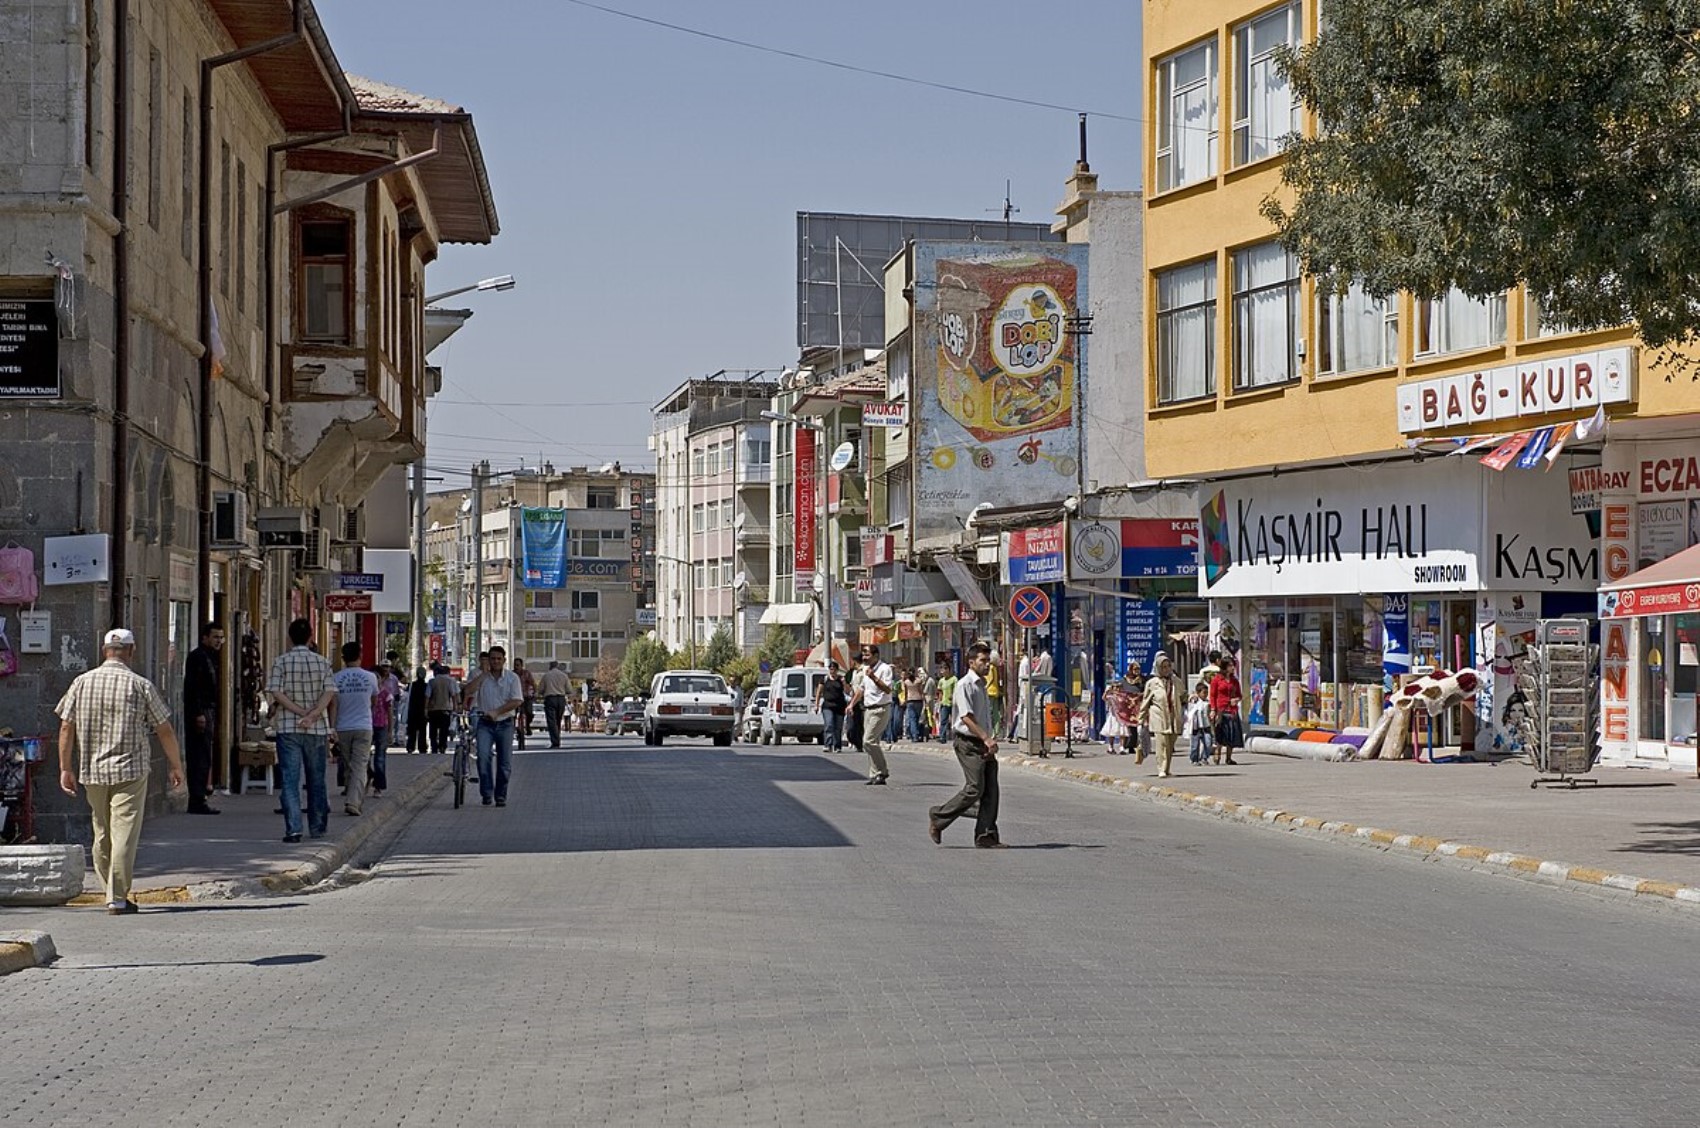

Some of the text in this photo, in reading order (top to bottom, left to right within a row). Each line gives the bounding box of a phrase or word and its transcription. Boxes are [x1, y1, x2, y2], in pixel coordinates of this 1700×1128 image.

[1010, 340, 1052, 368] LOP
[864, 402, 905, 416] AVUKAT
[1237, 498, 1427, 573] KAŞMİR HALI
[1414, 564, 1467, 584] SHOWROOM
[1496, 534, 1599, 585] KAŞM
[1604, 504, 1630, 742] ECANE
